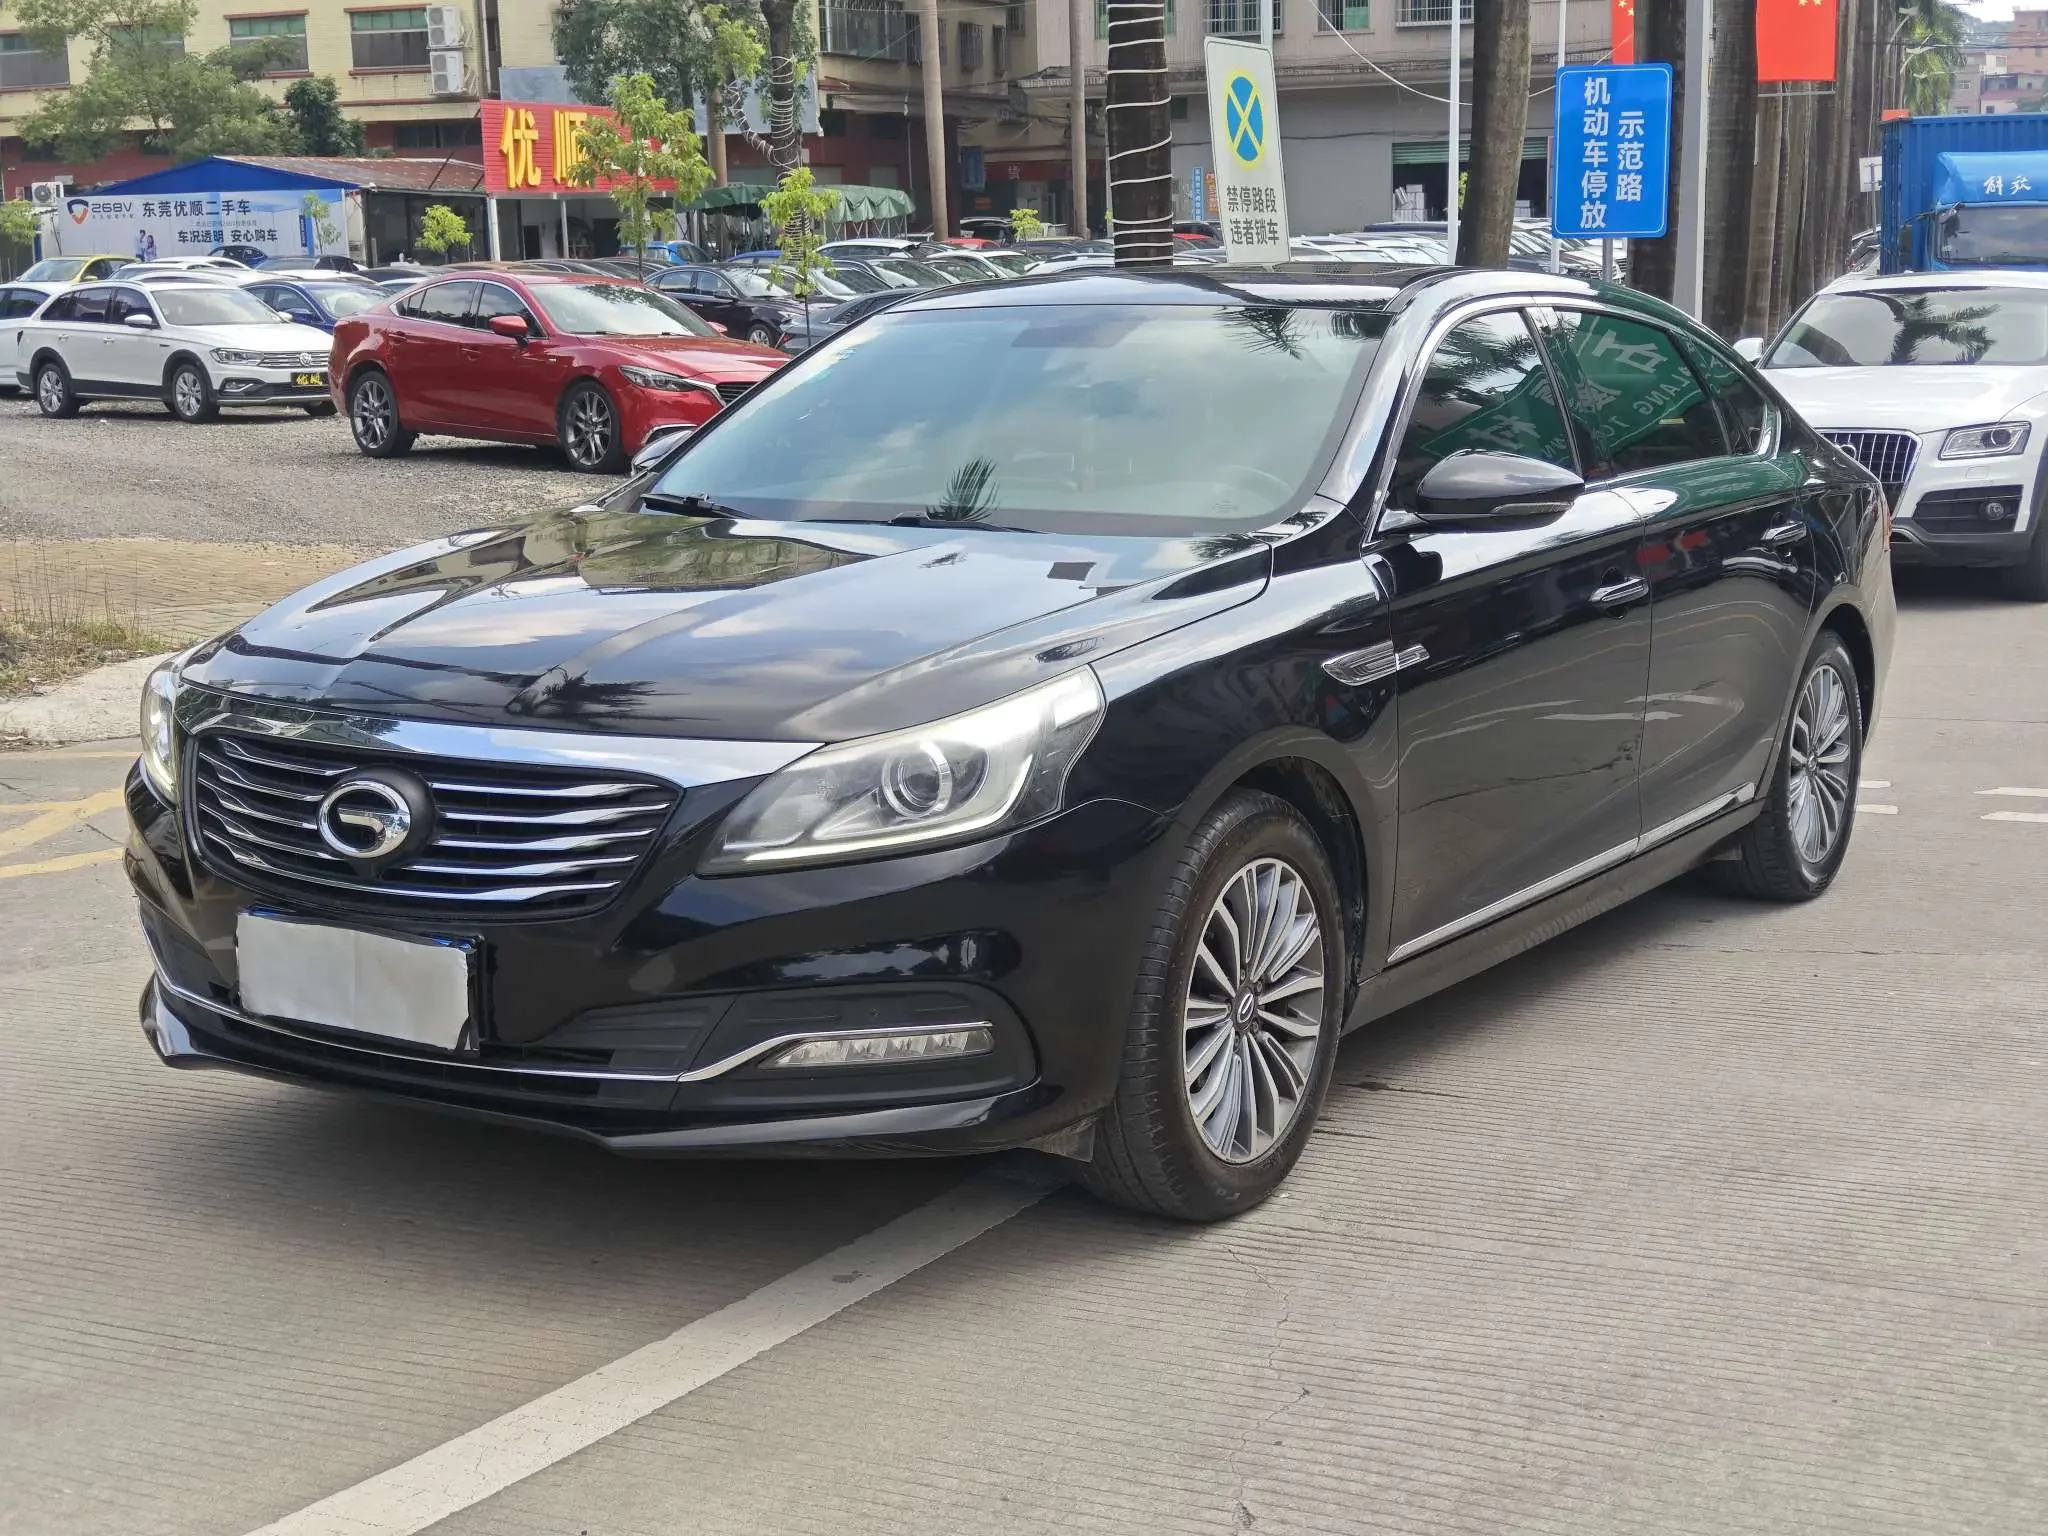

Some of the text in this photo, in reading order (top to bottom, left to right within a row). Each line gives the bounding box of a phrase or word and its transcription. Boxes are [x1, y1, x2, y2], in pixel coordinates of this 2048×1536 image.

[1579, 76, 1610, 229] 机动车停放
[1615, 111, 1645, 203] 示范路
[142, 198, 251, 218] 东莞优顺二手车
[1226, 185, 1277, 213] 禁停路段
[177, 228, 278, 243] 车况透明 安心购车
[1230, 217, 1279, 246] 违者锁车
